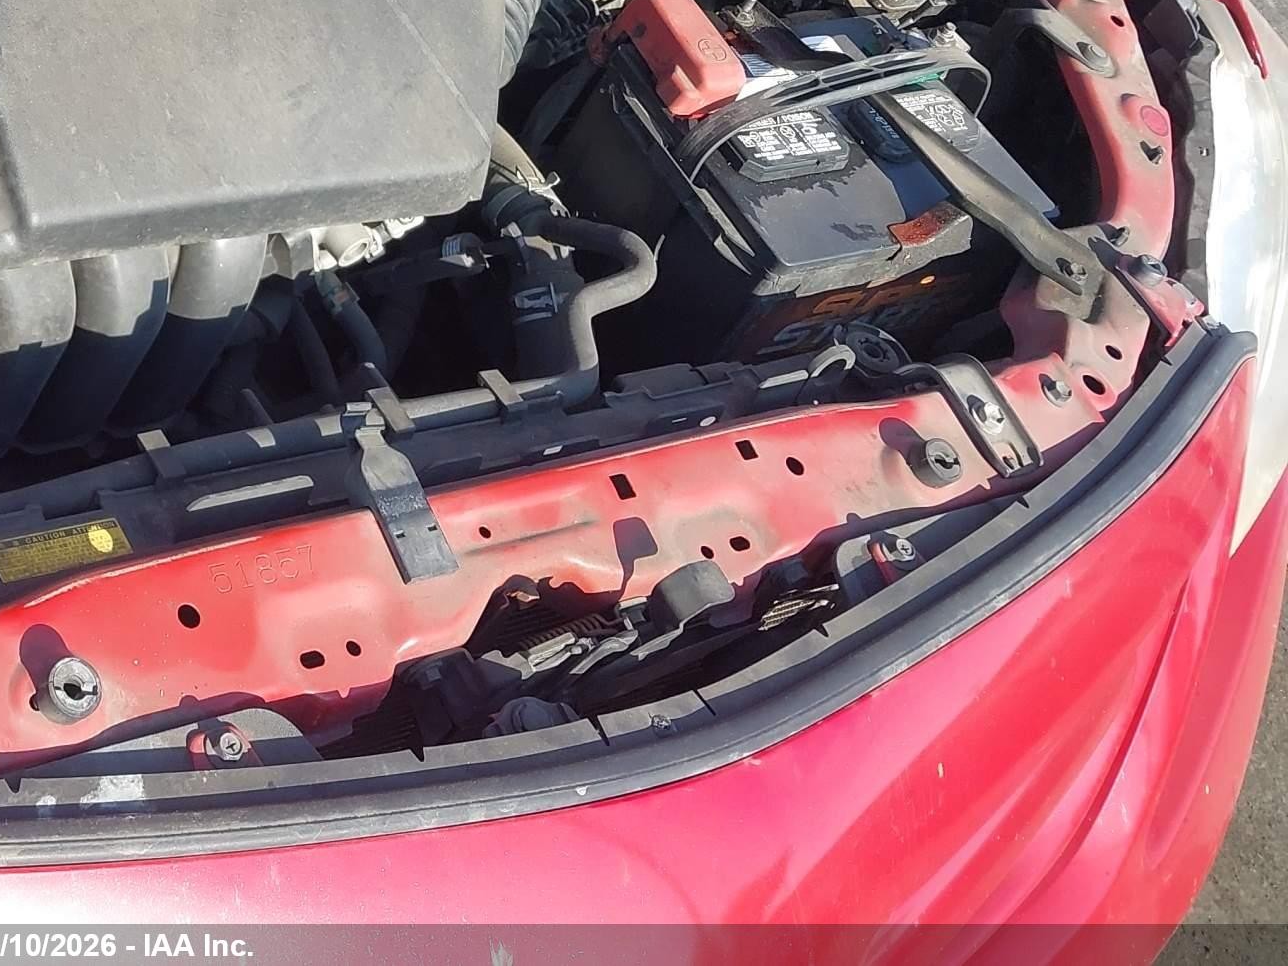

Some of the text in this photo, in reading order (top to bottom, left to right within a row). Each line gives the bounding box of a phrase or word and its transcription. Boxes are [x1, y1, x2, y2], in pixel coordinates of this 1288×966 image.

[24, 521, 115, 545] CAUTION ATTENTION
[208, 545, 313, 594] 51857
